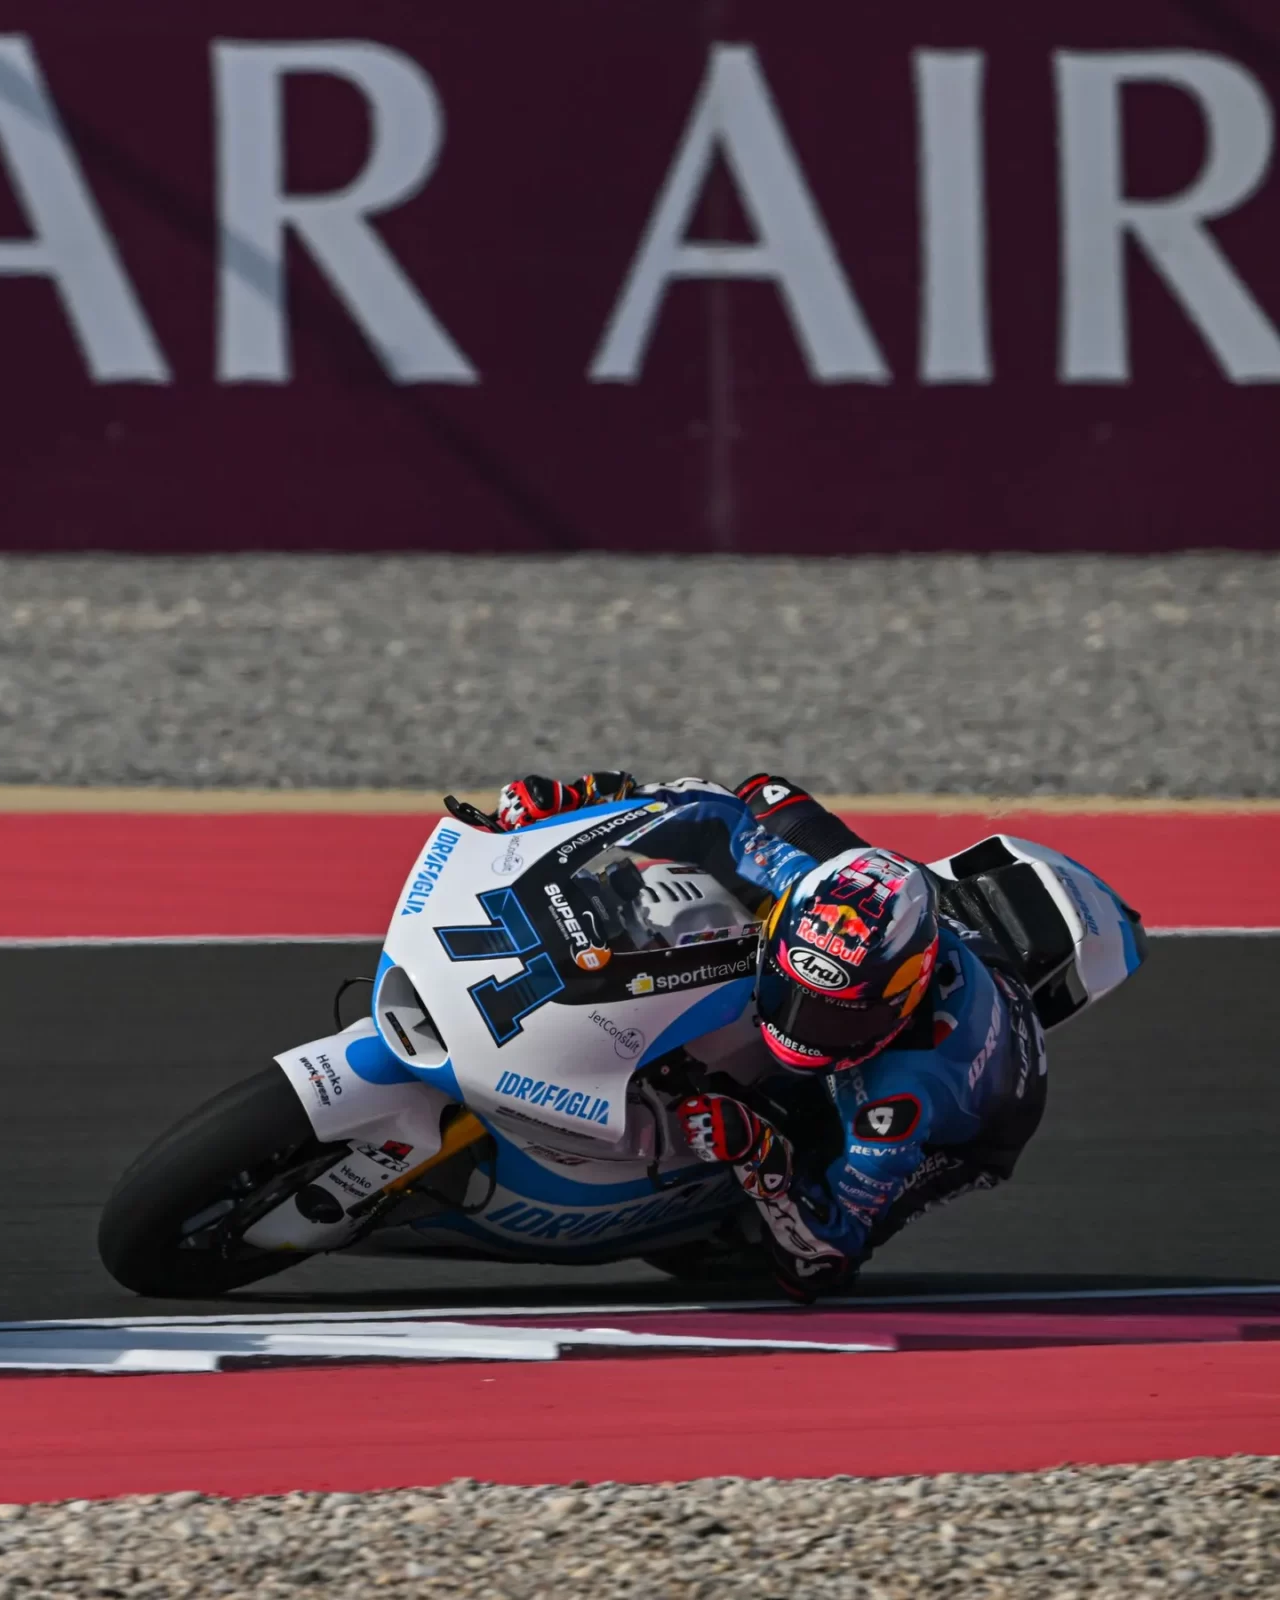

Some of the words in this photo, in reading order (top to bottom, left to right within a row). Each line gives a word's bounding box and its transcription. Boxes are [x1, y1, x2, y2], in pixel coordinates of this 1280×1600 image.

[544, 883, 589, 947] SUPER
[795, 916, 832, 951] Red
[829, 935, 870, 968] Bull
[433, 886, 566, 1048] 71
[792, 954, 843, 985] Arai
[588, 1010, 640, 1054] JetConsult
[316, 1054, 343, 1096] Henko
[339, 1164, 372, 1189] Henko
